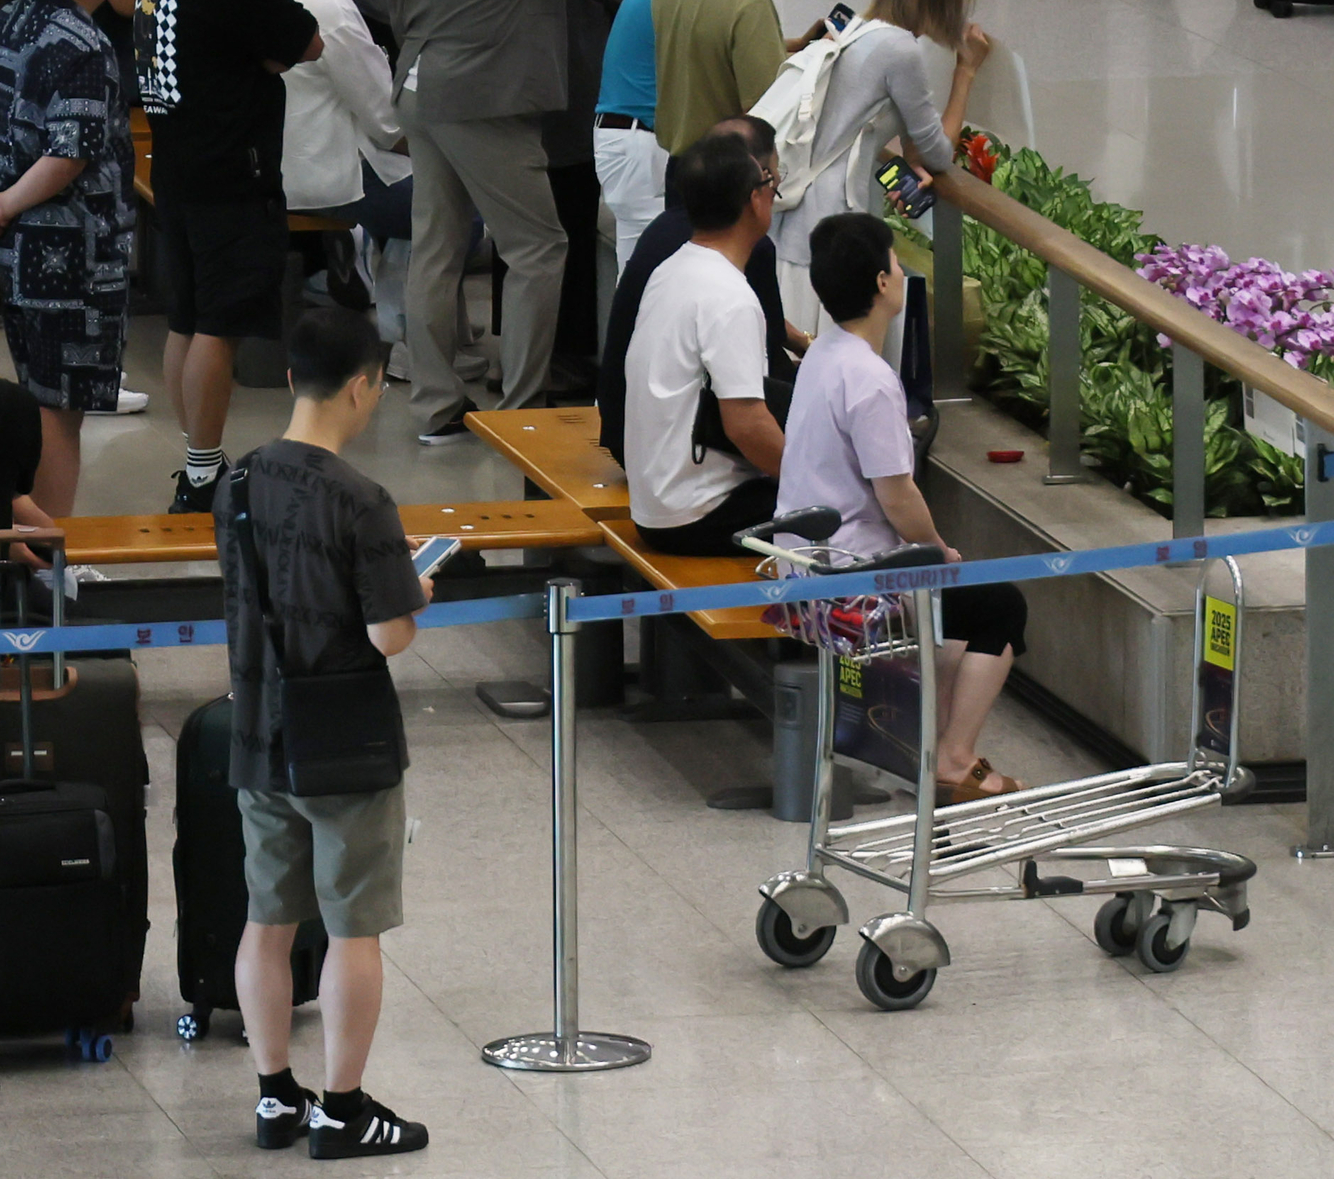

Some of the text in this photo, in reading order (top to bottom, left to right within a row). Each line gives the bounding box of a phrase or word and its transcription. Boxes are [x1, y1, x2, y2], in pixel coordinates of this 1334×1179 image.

[874, 568, 960, 591] SECURITY
[1211, 609, 1231, 631] 2025
[1211, 626, 1231, 647] APEC
[839, 665, 862, 688] APEC
